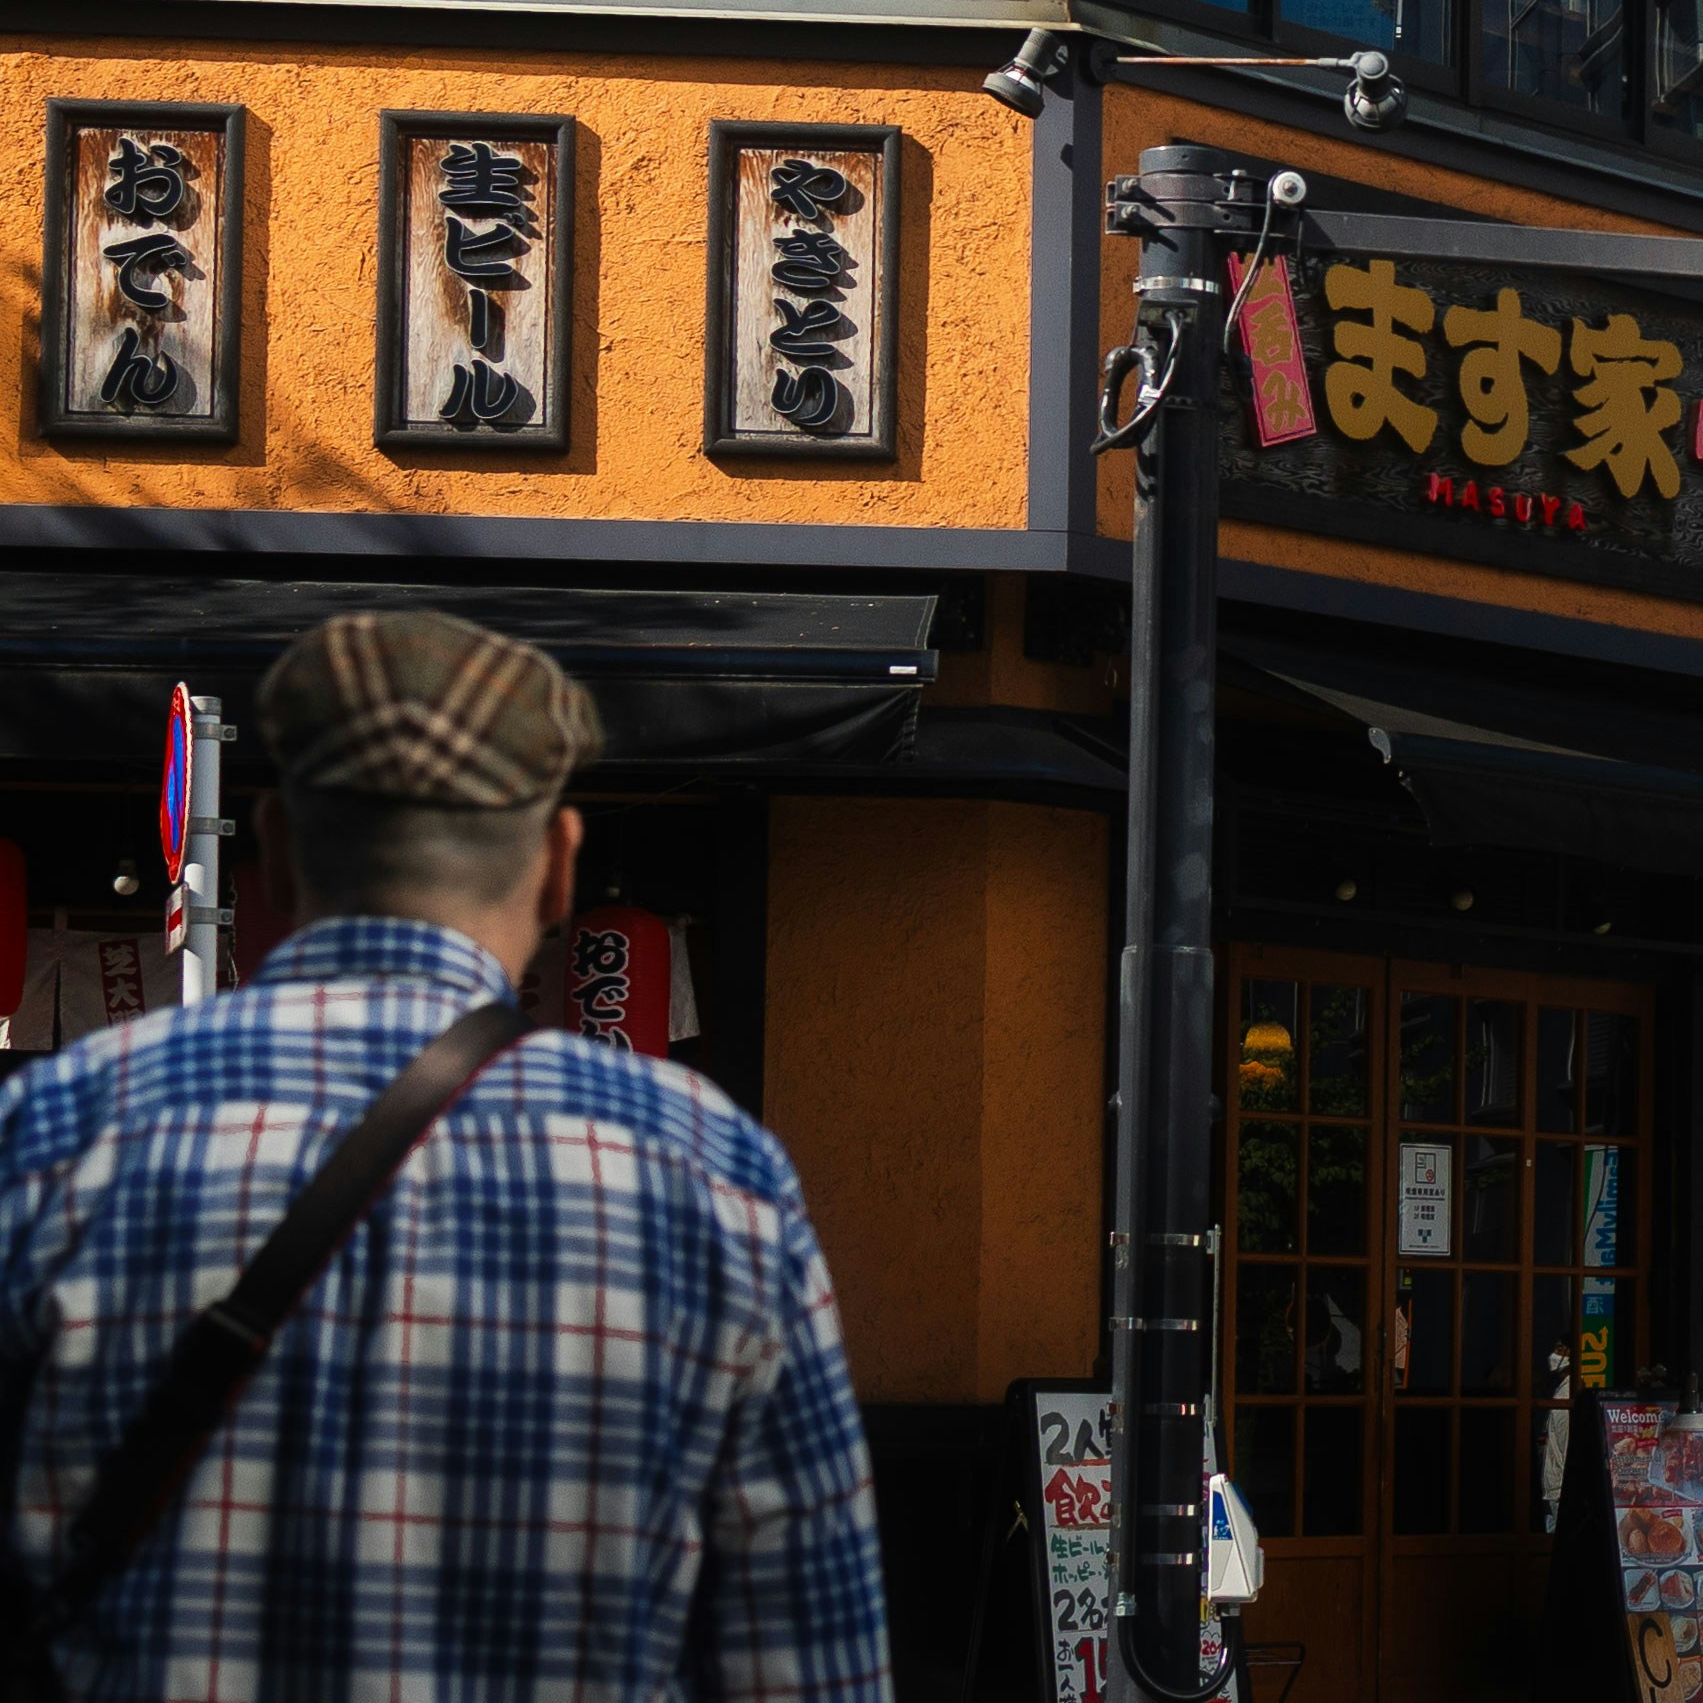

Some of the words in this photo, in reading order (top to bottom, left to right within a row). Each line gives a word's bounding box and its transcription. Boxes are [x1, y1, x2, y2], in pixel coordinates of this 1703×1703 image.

[102, 135, 182, 405] おでん
[438, 143, 524, 420] 生ビール
[769, 158, 847, 427] やきとり
[1325, 259, 1684, 498] ます家
[1429, 472, 1588, 531] MASUYA
[1607, 1409, 1664, 1423] Welcome
